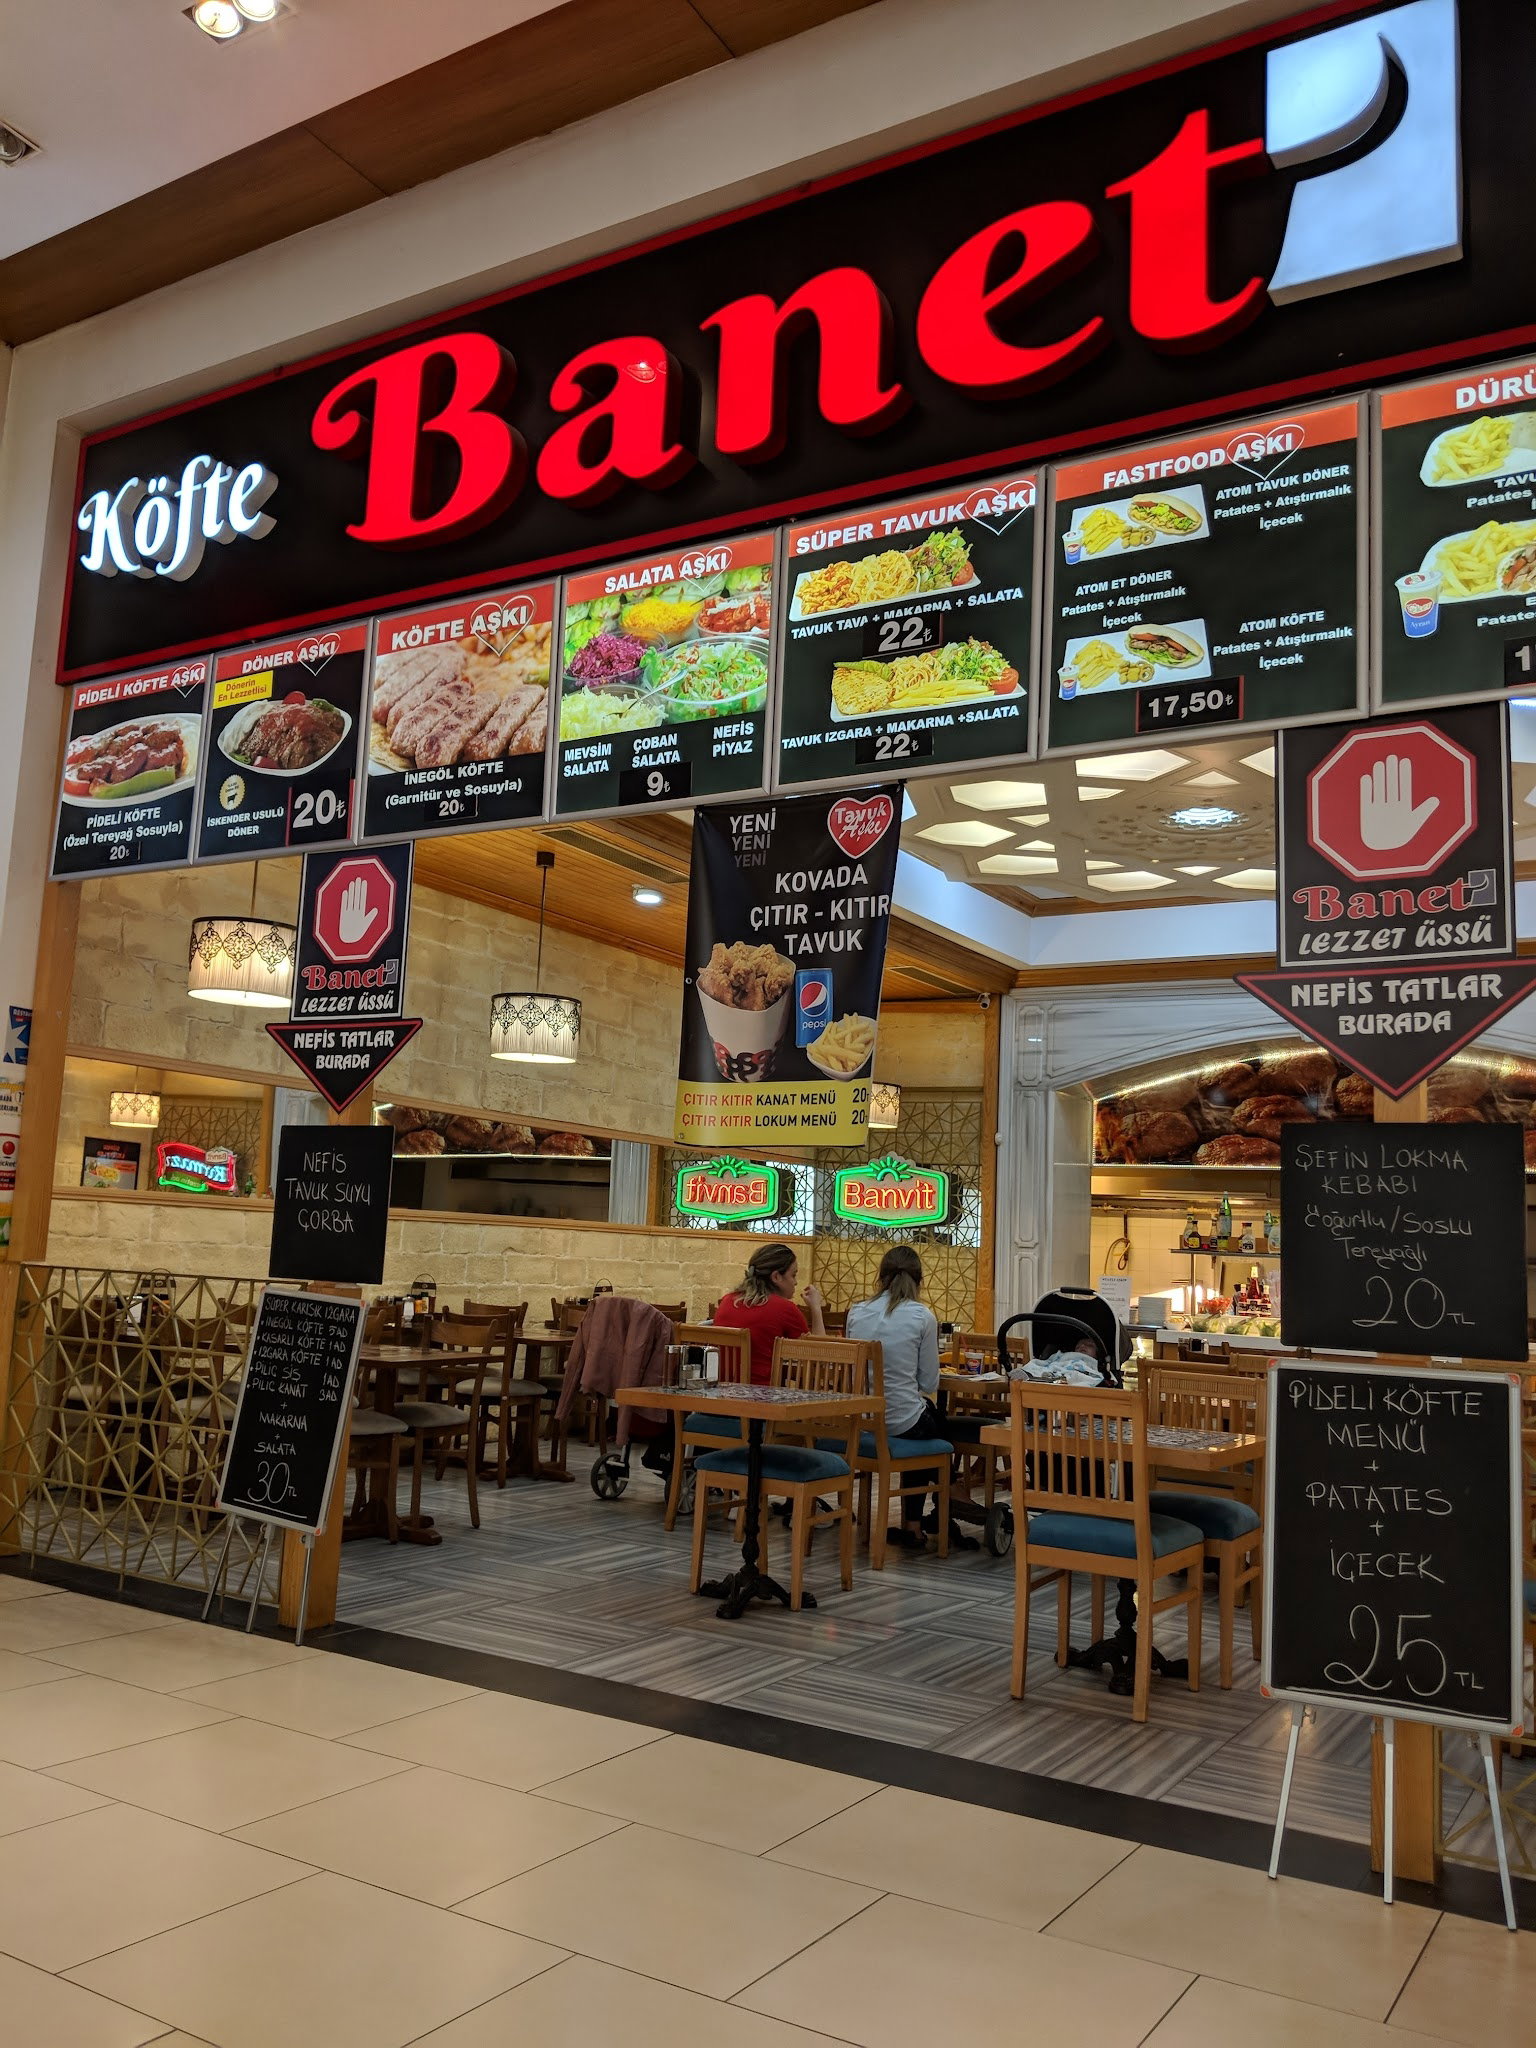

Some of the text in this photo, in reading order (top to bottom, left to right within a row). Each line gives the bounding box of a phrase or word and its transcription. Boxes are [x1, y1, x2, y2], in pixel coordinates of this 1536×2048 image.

[310, 108, 1263, 542] Banet
[1103, 432, 1293, 490] FASTFOOD AŞKI
[1215, 464, 1350, 501] ATOM TAVUK DÖNER
[1213, 484, 1352, 519] Patates Atıştırmalık
[1466, 489, 1533, 508] Patates
[78, 455, 265, 577] Köfte
[796, 488, 1036, 555] SÜPER TAVUK AŞKI
[1259, 511, 1303, 531] İçecek
[604, 552, 727, 594] SALATA AŞKI
[1075, 569, 1173, 597] ATOM ET DÖNER
[791, 587, 1024, 640] TAVUK TAVA MAKARNA SALATA
[1062, 585, 1187, 618] Patates Atıştırmalık
[391, 604, 528, 651] KÖFTE AŞKI
[1102, 612, 1143, 629] İçecek
[1239, 610, 1325, 634] ATOM KÖFTE
[1476, 611, 1536, 627] Patate
[1212, 625, 1353, 657] Patates Atıştırmalık
[242, 641, 336, 675] DÖNER AŞKI
[1259, 653, 1304, 671] İçecek
[77, 667, 205, 706] PİDELİ KÖFTE AŞKI
[218, 684, 268, 702] En Lezzetlisi
[225, 677, 257, 692] Dönerin
[632, 720, 755, 754] ÇOBAN NEFİS
[782, 734, 822, 750] TAVUK
[824, 725, 872, 743] IZGARA
[886, 713, 955, 736] MAKARNA
[564, 741, 612, 762] MEVSİM
[631, 737, 753, 769] SALATA PİYAZ
[404, 761, 504, 786] İNEGÖL KÖFTE
[563, 759, 610, 778] SALATA
[385, 777, 523, 810] (Garnitür ve Sosuyla)
[86, 806, 161, 829] PİDELİ KÖFTE
[206, 806, 285, 828] İSKENDER USULÜ
[729, 807, 777, 835] YENİ
[834, 801, 887, 825] Tavuk
[63, 819, 184, 851] (Özel Tereyağ Sosuyla)
[227, 824, 260, 838] DÖNER
[732, 831, 772, 852] YENİ
[733, 851, 767, 868] YENİ
[775, 863, 868, 894] KOVADA
[750, 894, 890, 931] ÇITIR KITIR
[1292, 877, 1473, 922] Banet
[784, 928, 863, 956] TAVUK
[1415, 914, 1493, 948] ÜSSÜ
[301, 963, 388, 991] Banet
[1290, 973, 1504, 1007] NEFİS TATLAR
[1338, 1009, 1452, 1036] BURADA
[294, 1028, 395, 1049] NEFİS TATLAR
[315, 1053, 371, 1070] BURADA
[683, 1092, 718, 1107] ÇITIR
[721, 1094, 753, 1106] KITIR
[756, 1093, 797, 1106] KANAT
[800, 1090, 837, 1105] MENÜ
[682, 1113, 716, 1127] ÇITIR
[720, 1115, 752, 1127] KITIR
[755, 1115, 797, 1127] LOKUM
[801, 1112, 837, 1126] MENÜ
[303, 1148, 347, 1174] NEFİS
[1295, 1143, 1468, 1172] ŞEFİN LOKMA
[284, 1177, 371, 1206] TAVUK SUYU
[844, 1178, 936, 1210] Banvit
[1321, 1175, 1417, 1195] KEBABI
[297, 1208, 355, 1233] ÇORBA
[265, 1296, 289, 1314] SÜPER
[278, 1382, 309, 1398] KANAT
[1289, 1377, 1484, 1416] PİDELİ KÖFTE
[259, 1411, 308, 1432] MAKARNA
[254, 1442, 297, 1455] SALATA
[1327, 1419, 1427, 1455] MENÜ
[1305, 1481, 1453, 1516] PATATES
